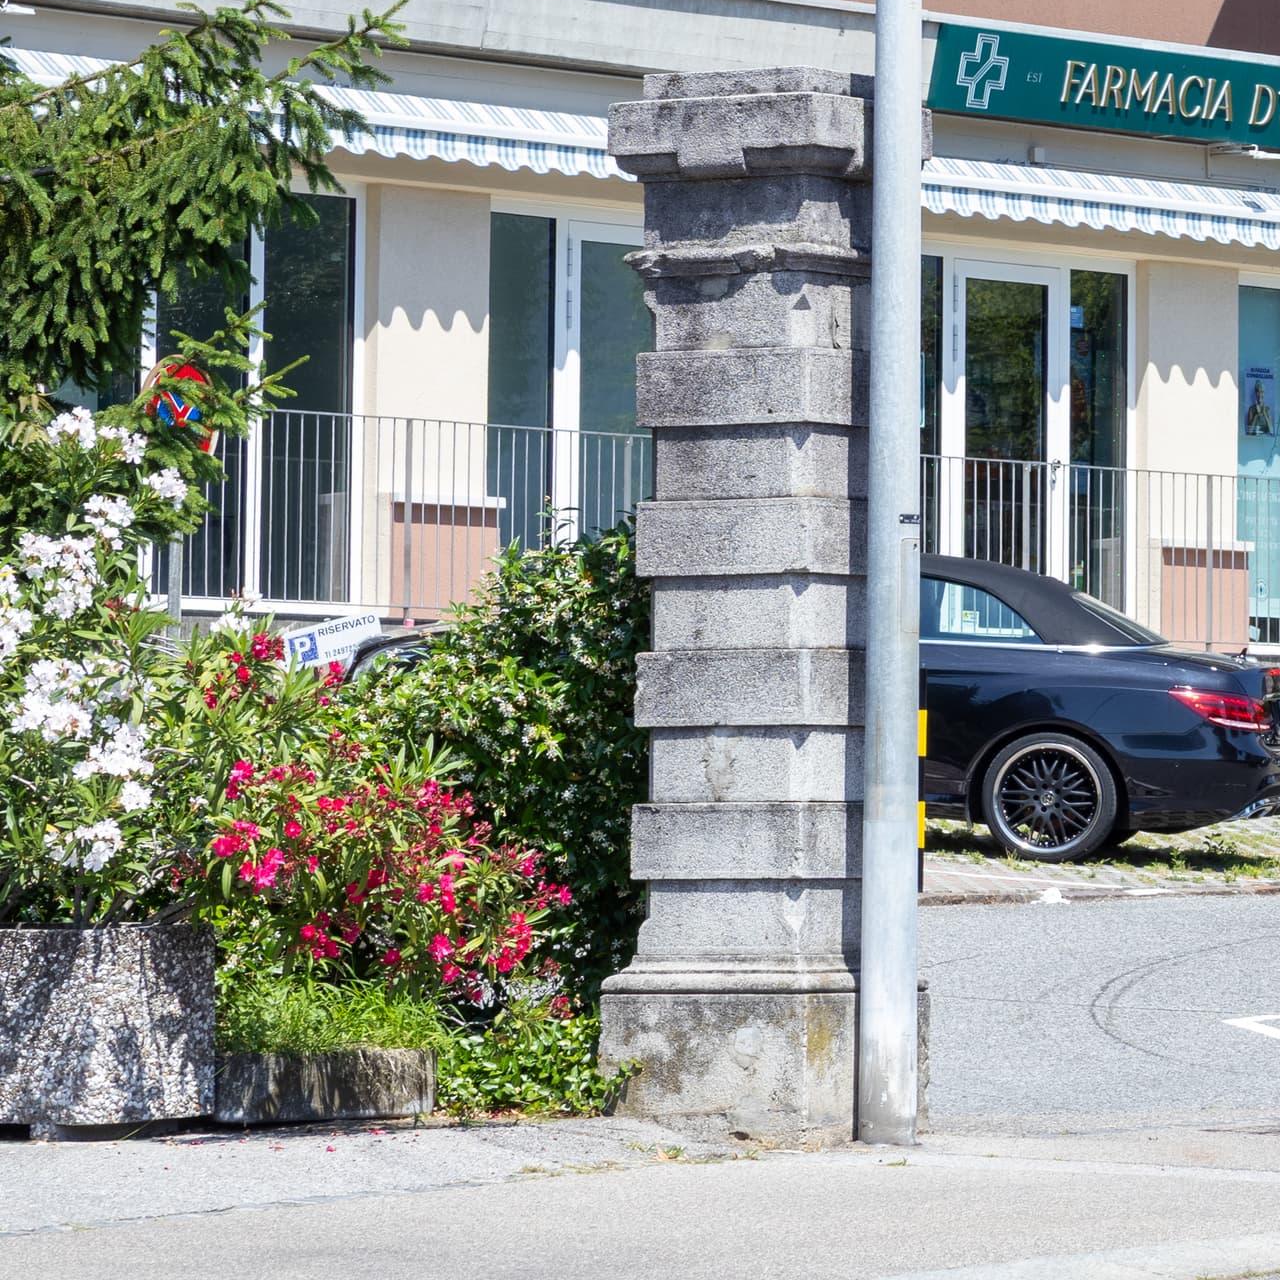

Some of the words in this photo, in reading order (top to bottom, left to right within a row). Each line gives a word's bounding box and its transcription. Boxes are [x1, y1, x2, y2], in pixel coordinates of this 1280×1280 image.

[1026, 71, 1043, 83] EST
[1060, 60, 1233, 122] FARMACIA
[318, 615, 375, 637] RISERVATO
